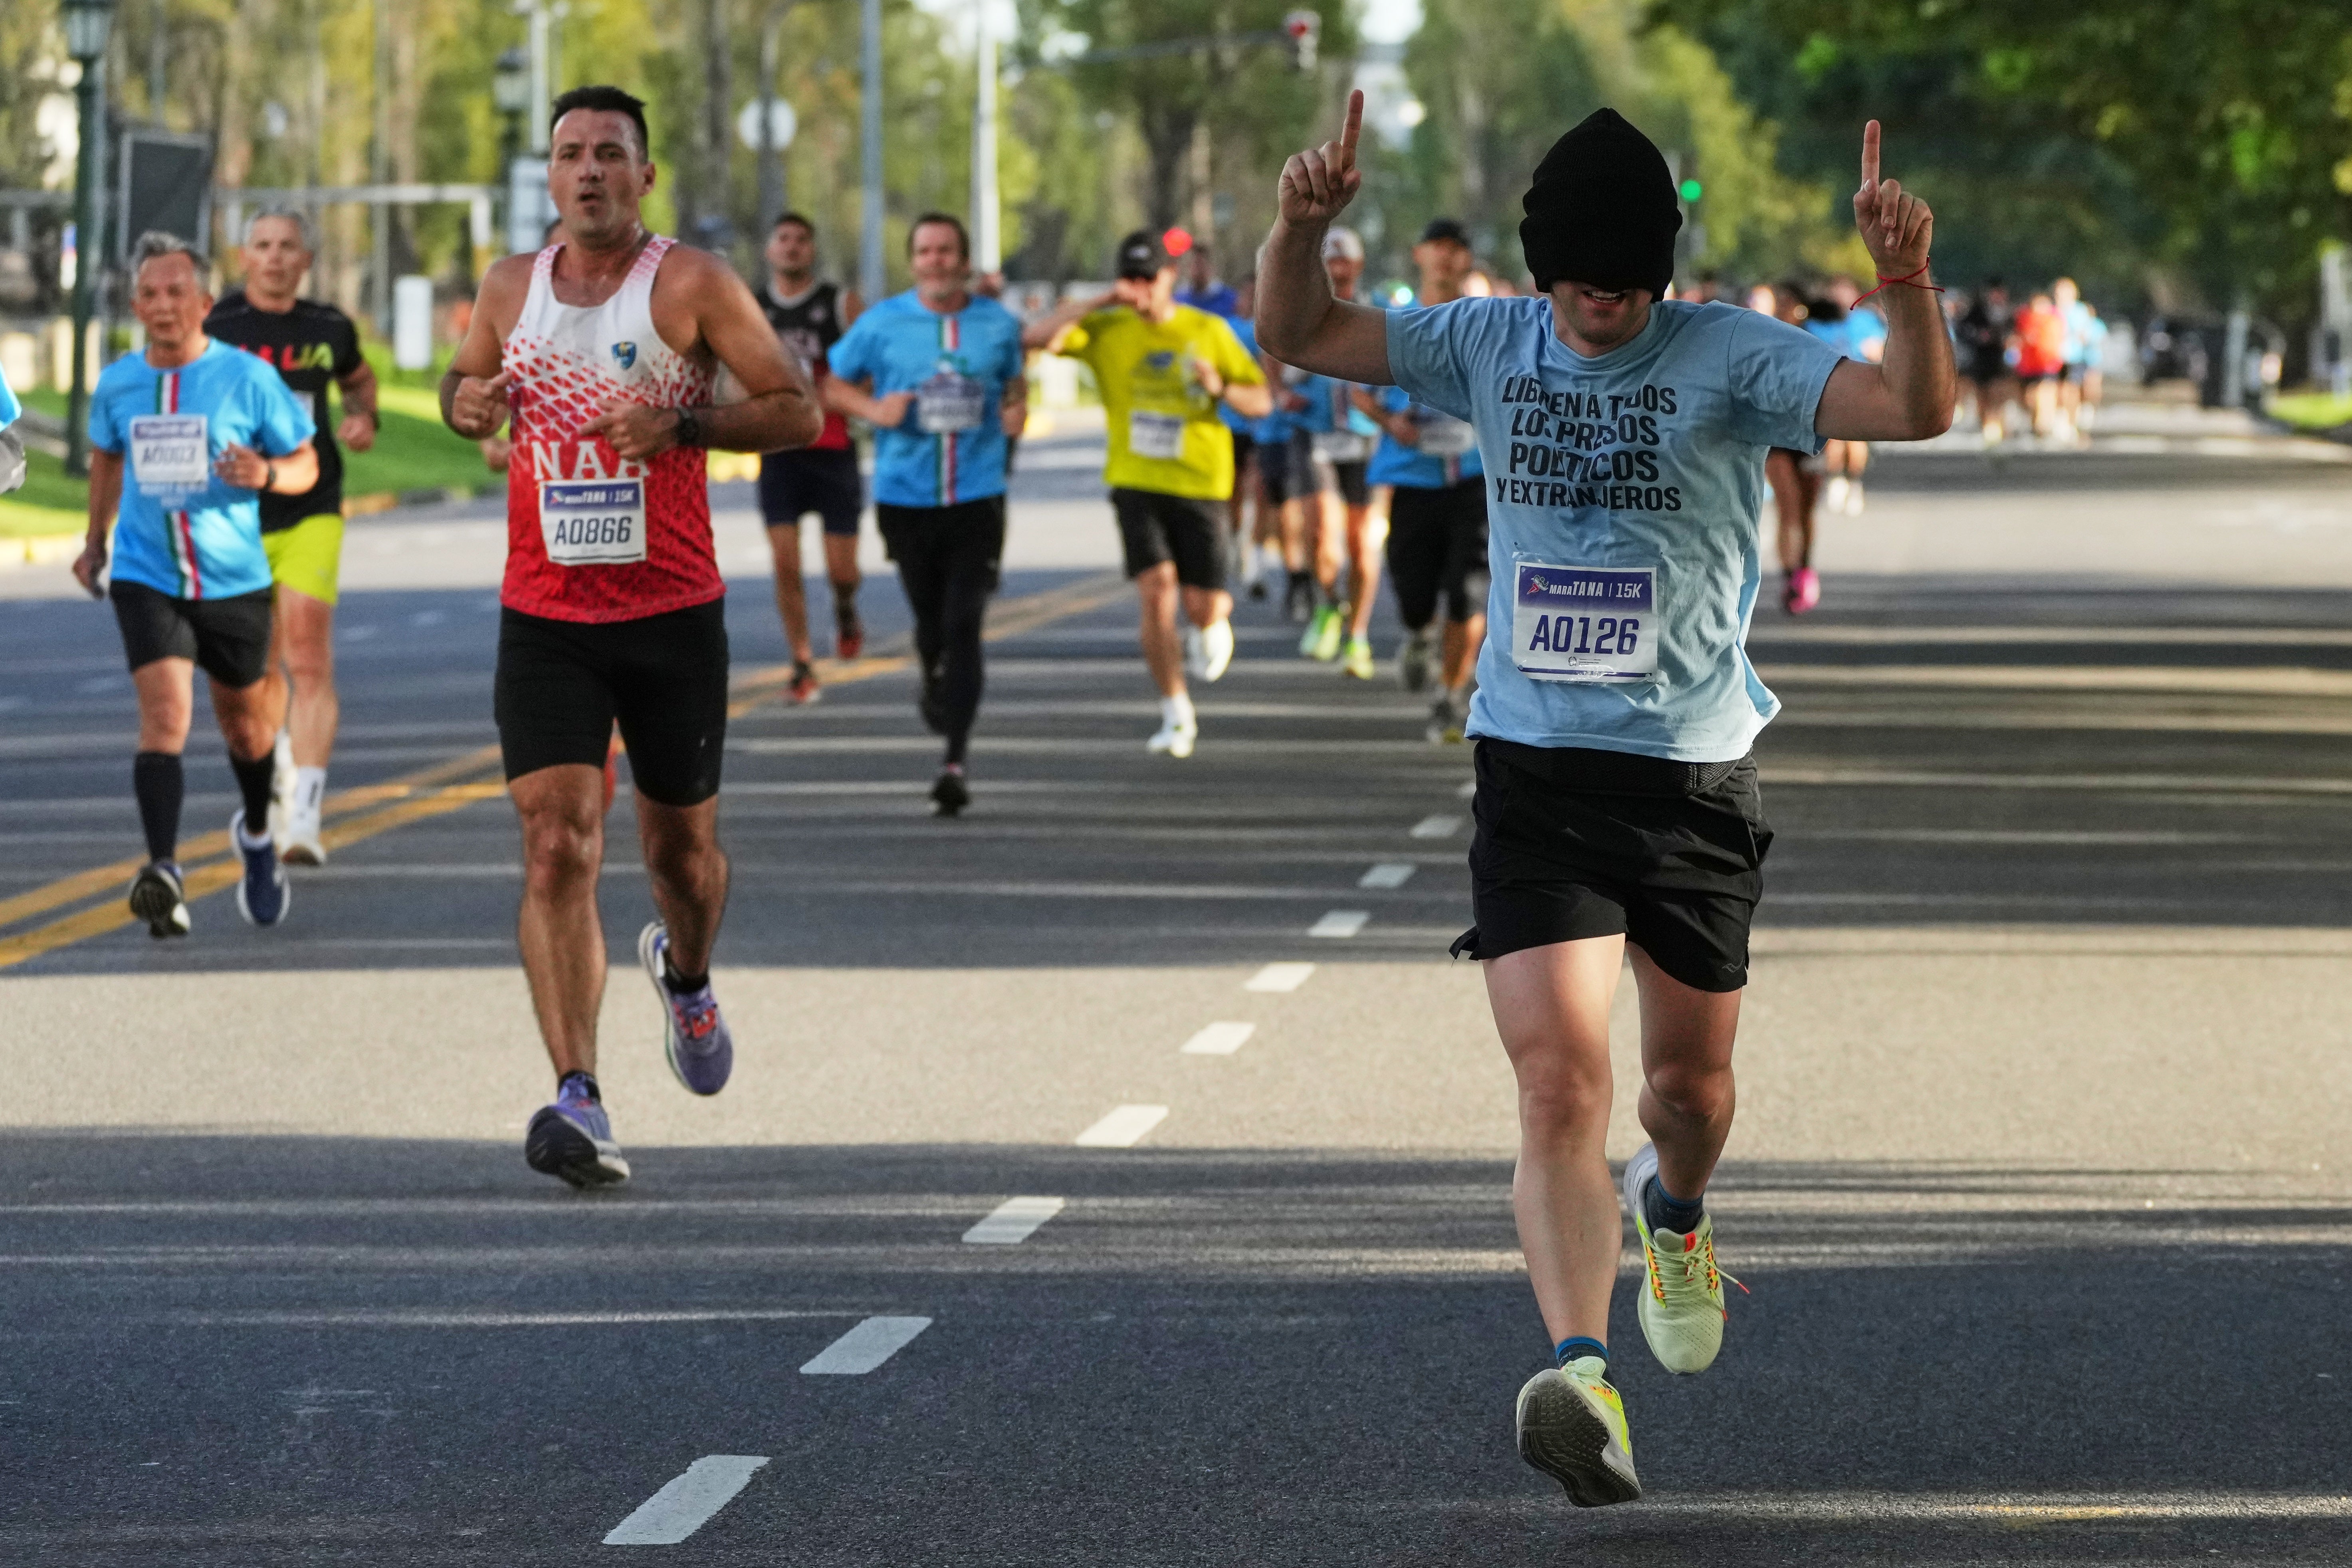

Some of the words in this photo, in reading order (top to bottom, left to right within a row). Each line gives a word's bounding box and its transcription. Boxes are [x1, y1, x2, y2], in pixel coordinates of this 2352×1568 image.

[1586, 394, 1601, 418] A
[554, 516, 632, 545] A0866
[1615, 583, 1642, 598] 15K
[1529, 615, 1639, 655] A0126
